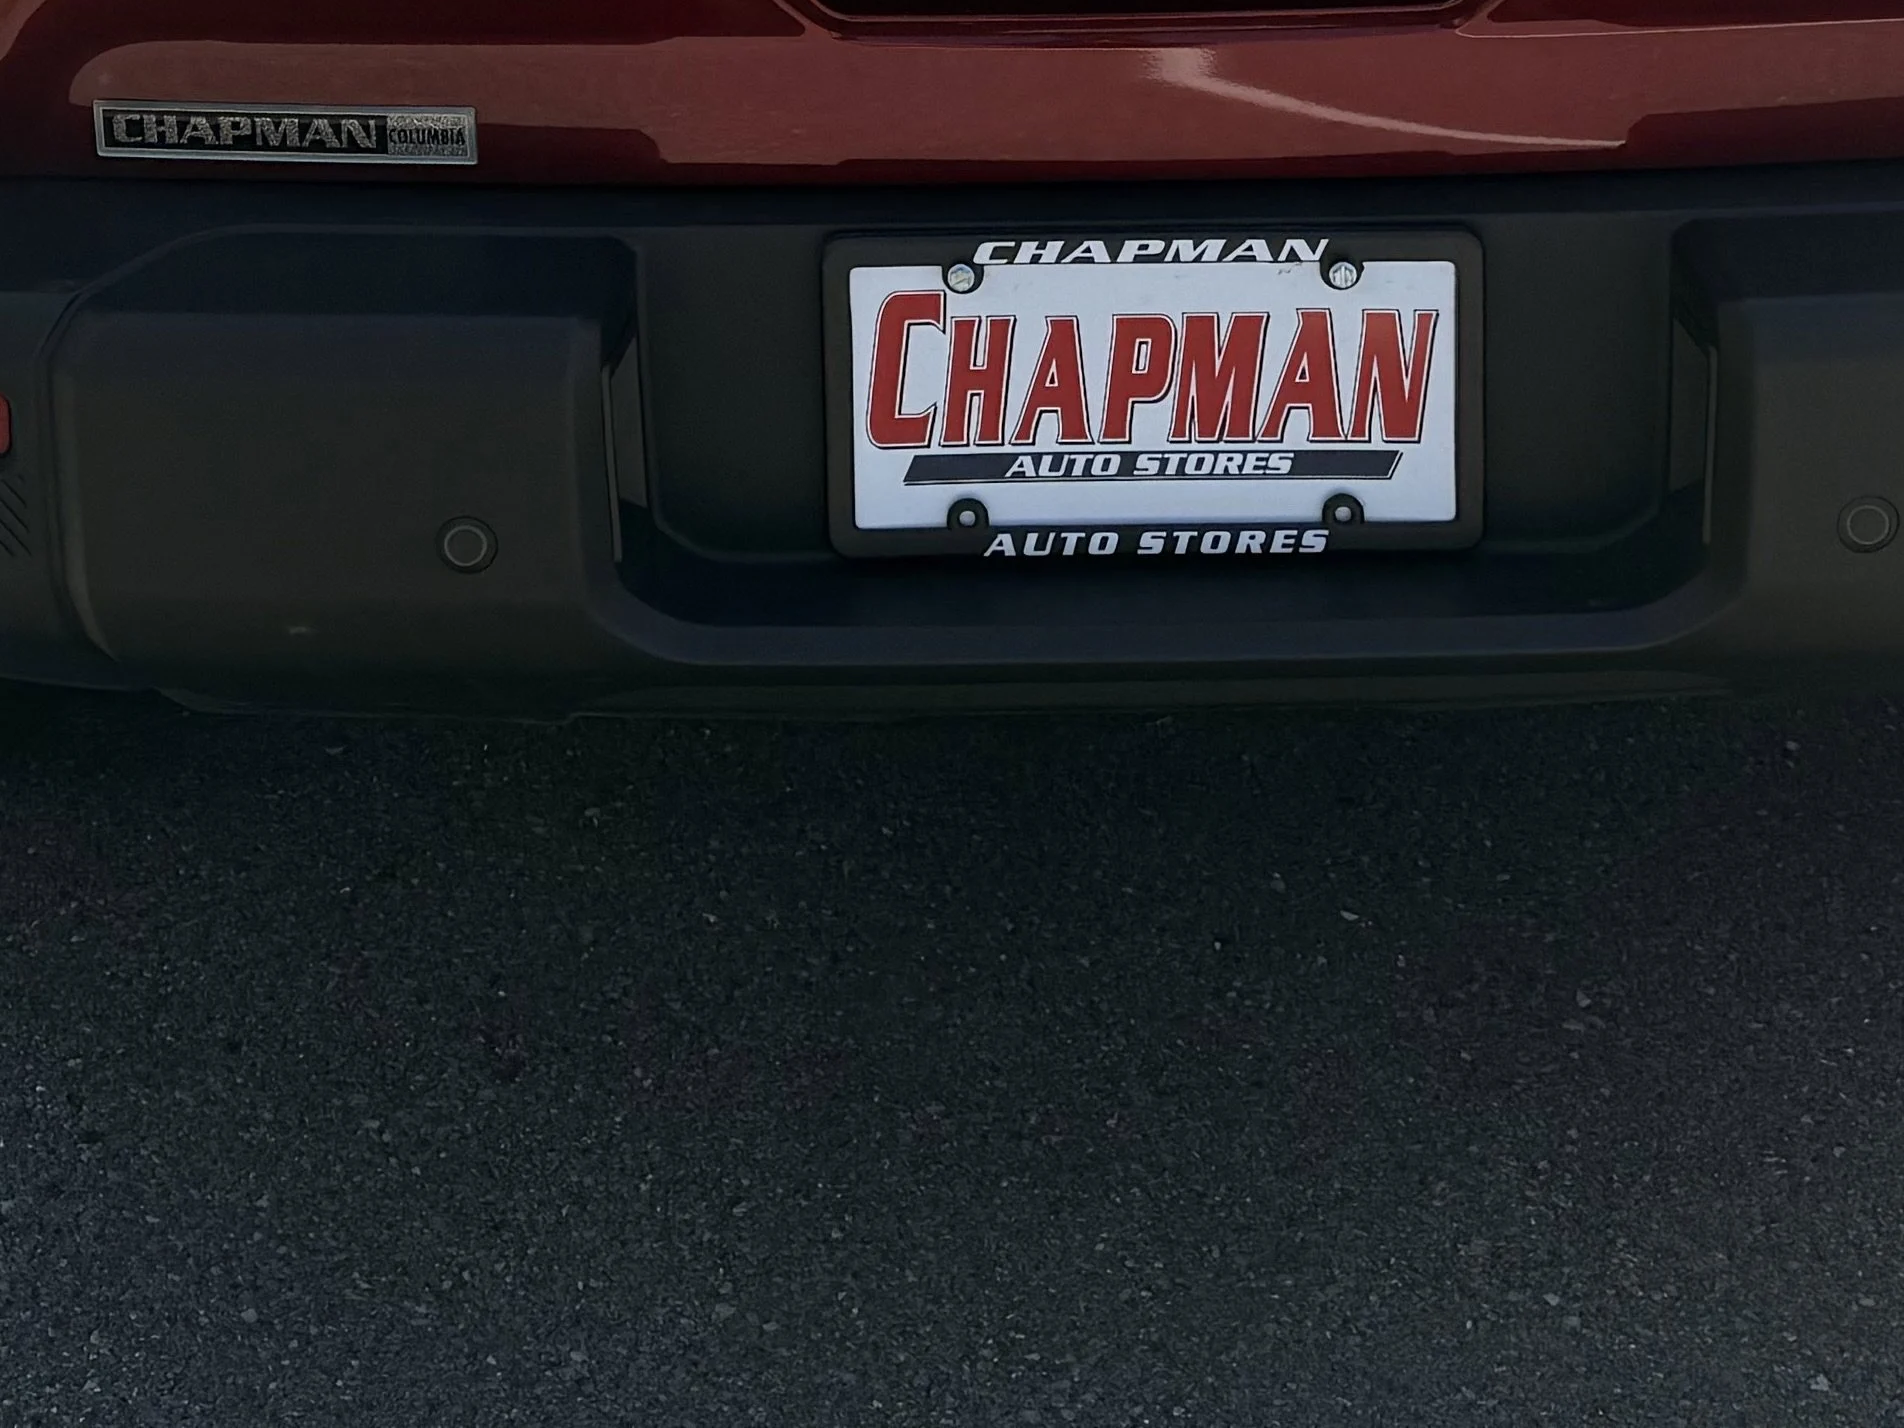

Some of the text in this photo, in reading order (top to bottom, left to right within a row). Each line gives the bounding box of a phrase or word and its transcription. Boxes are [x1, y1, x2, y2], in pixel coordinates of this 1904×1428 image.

[111, 113, 467, 149] CHAPMAN COLUMBIA
[972, 237, 1330, 266] CHAPMAN
[866, 290, 1438, 448] CHAPMAN
[1004, 451, 1296, 479] AUTO STORES
[982, 528, 1331, 558] AUTO STORES
